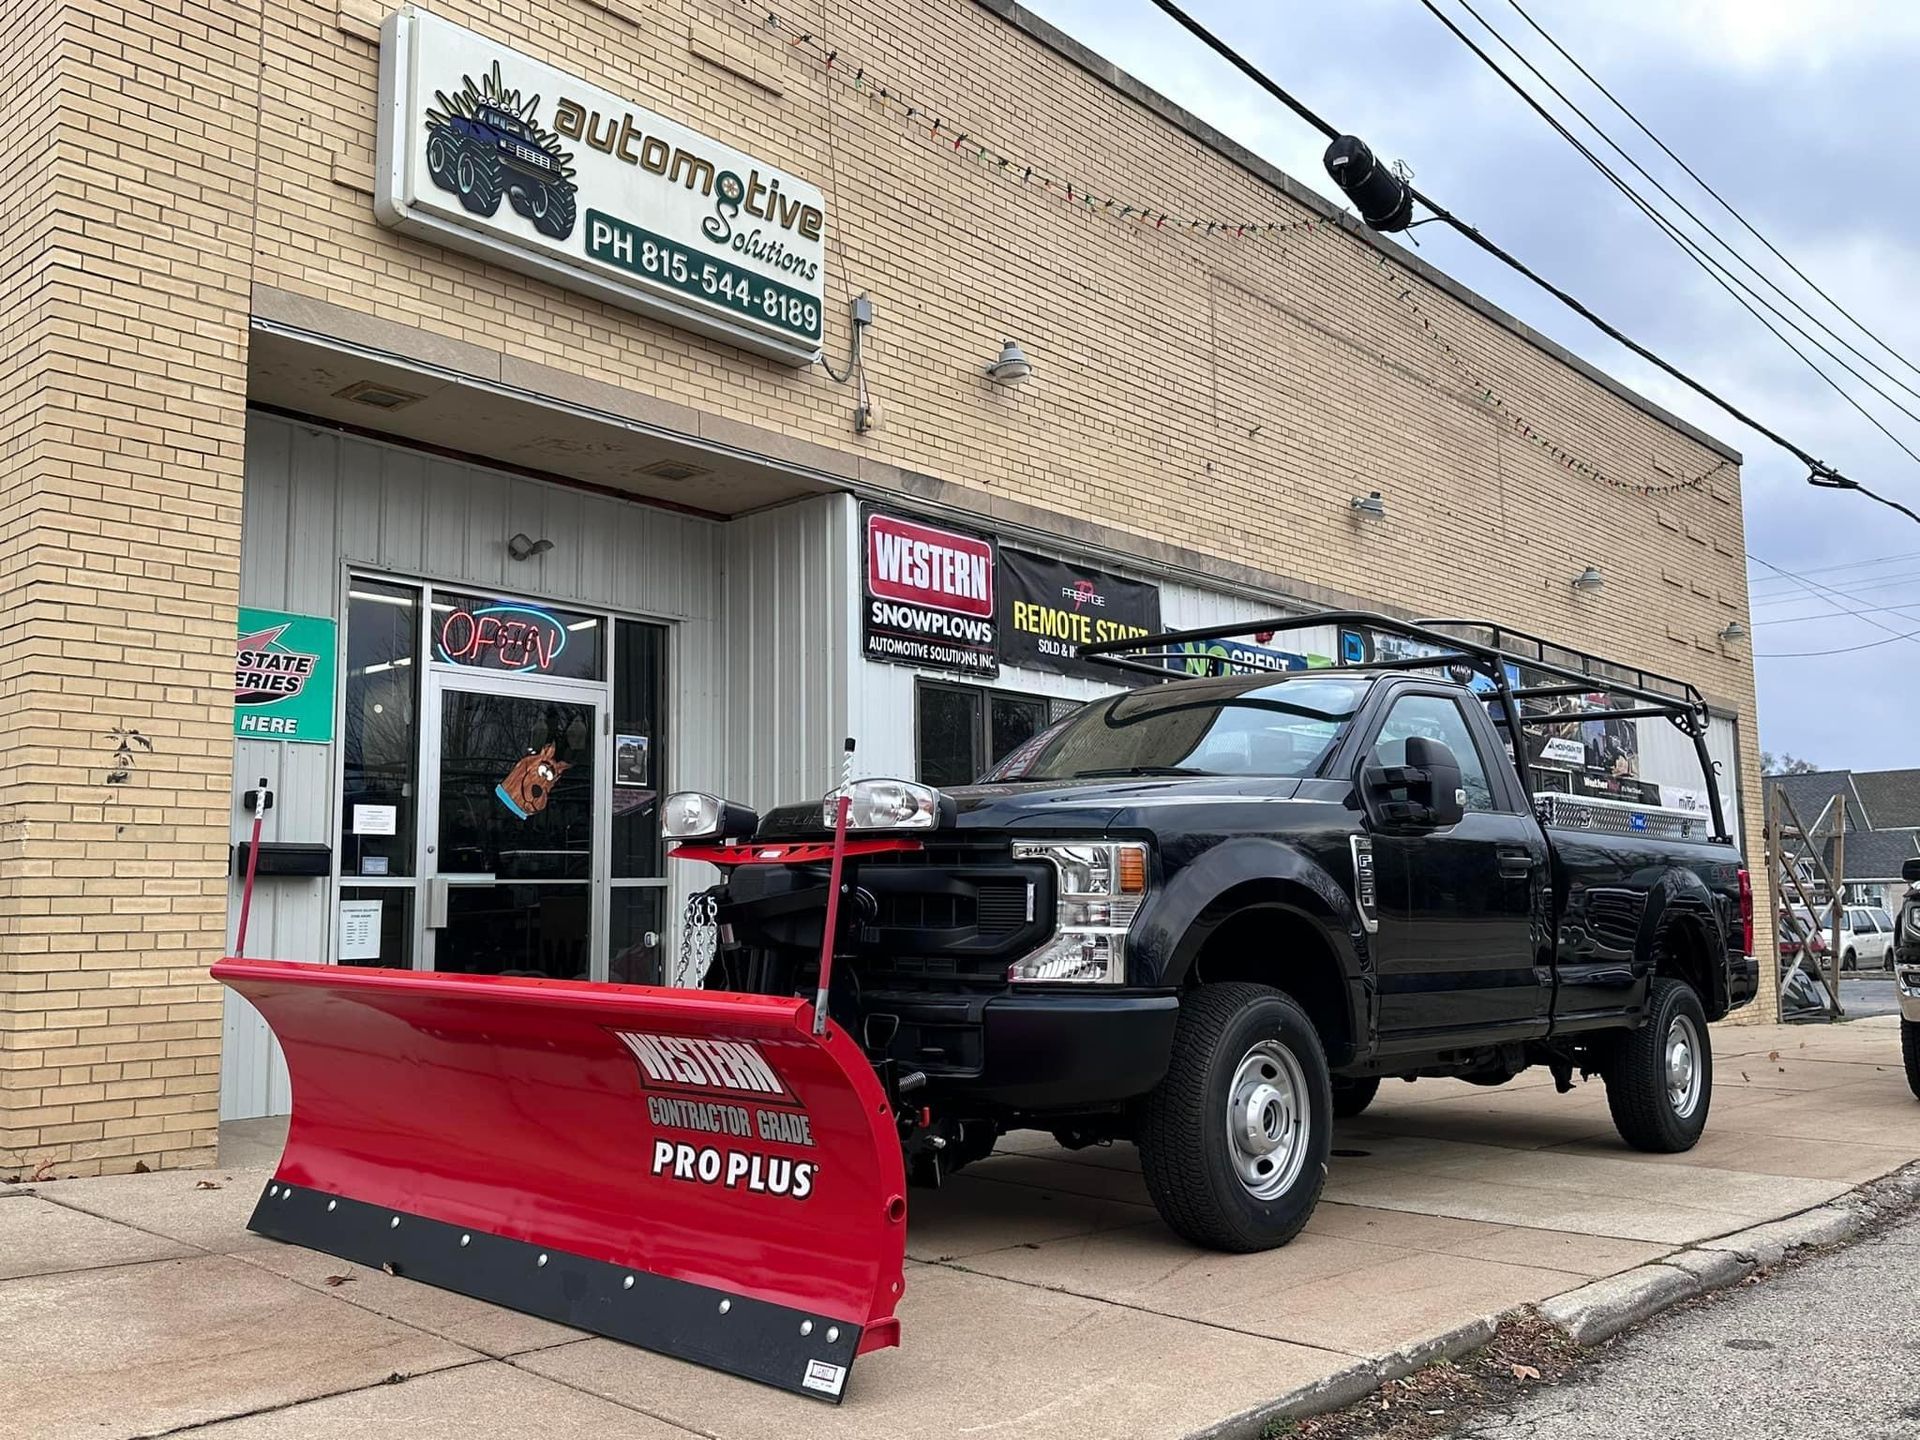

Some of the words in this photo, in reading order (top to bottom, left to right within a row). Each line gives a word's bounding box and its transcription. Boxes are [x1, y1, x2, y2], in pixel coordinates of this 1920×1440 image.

[553, 96, 823, 243] automotive
[701, 198, 819, 282] Solutions
[592, 218, 634, 264] PH
[641, 240, 819, 332] 815-544-8189
[874, 530, 988, 602] WESTERN
[1061, 586, 1106, 607] PRESTIGE
[442, 611, 555, 669] OPEN
[871, 601, 993, 643] SNOWPLOWS
[1013, 599, 1092, 645] REMOTE
[236, 650, 313, 674] STATE
[868, 635, 929, 659] AUTOMOTIVE
[929, 645, 978, 667] SOLUTIONS
[978, 653, 996, 669] INC.
[1038, 638, 1060, 656] SOLD
[1061, 643, 1069, 657] &
[236, 671, 301, 693] ERIES
[240, 714, 299, 735] HERE
[614, 1030, 785, 1095] WESTERN
[647, 1096, 753, 1138] CONTRACTOR
[756, 1108, 814, 1146] GRADE
[652, 1139, 722, 1182] PRO
[725, 1151, 814, 1198] PLUS
